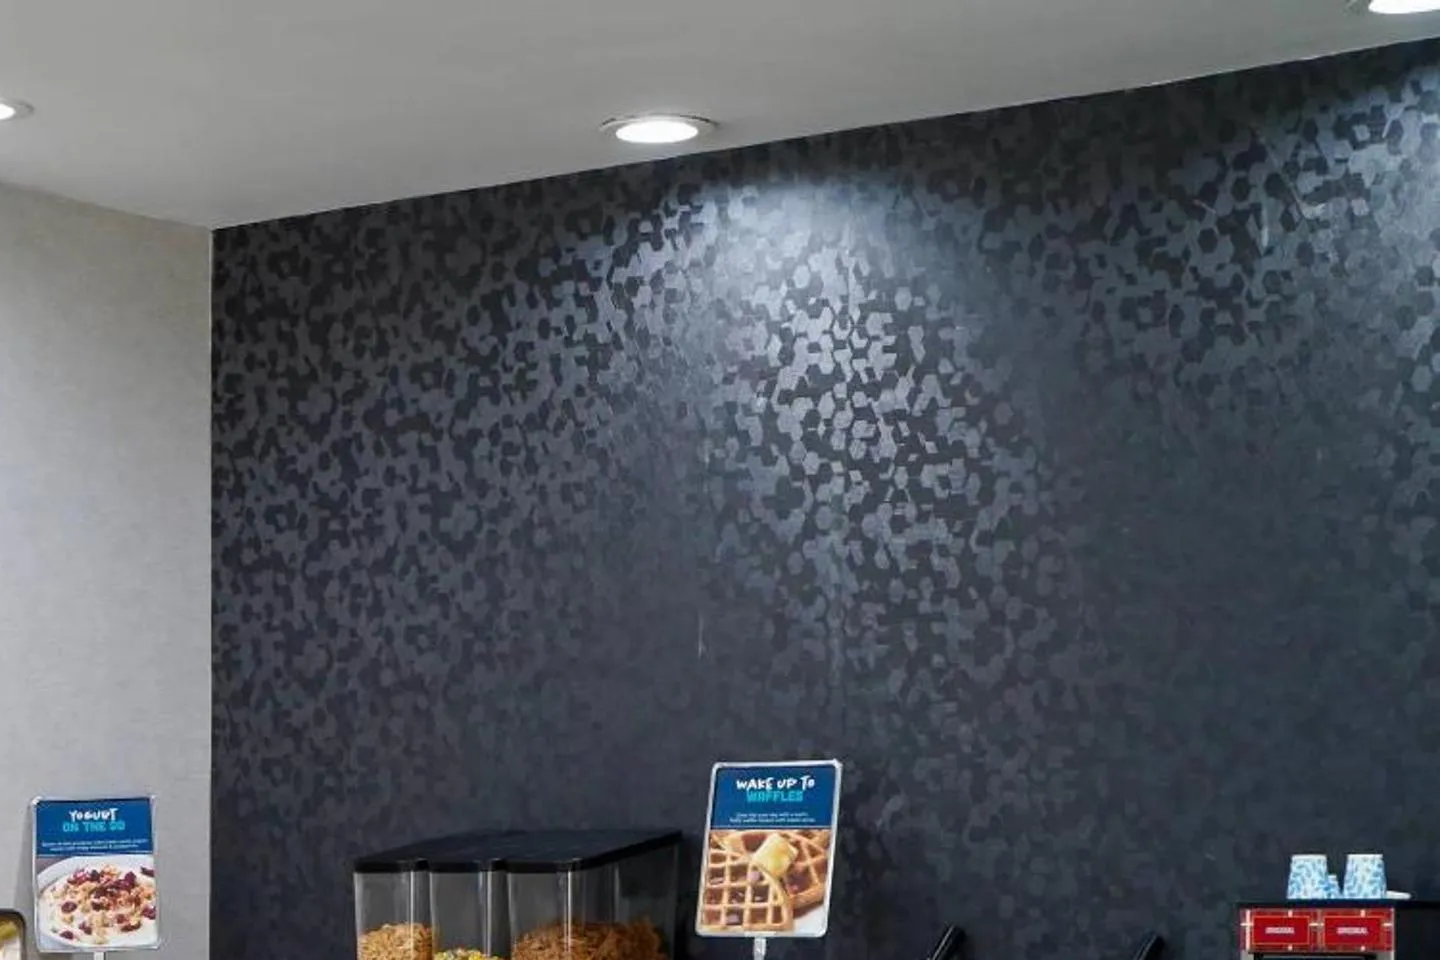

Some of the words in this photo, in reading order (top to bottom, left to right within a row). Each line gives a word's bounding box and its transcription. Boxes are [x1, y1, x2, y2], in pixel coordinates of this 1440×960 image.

[736, 777, 776, 791] WAKE
[777, 778, 798, 790] UP
[746, 789, 804, 803] WAFFLES
[69, 807, 119, 822] YOGURT
[63, 823, 79, 832] ON
[83, 821, 107, 832] THE
[109, 820, 125, 831] GO
